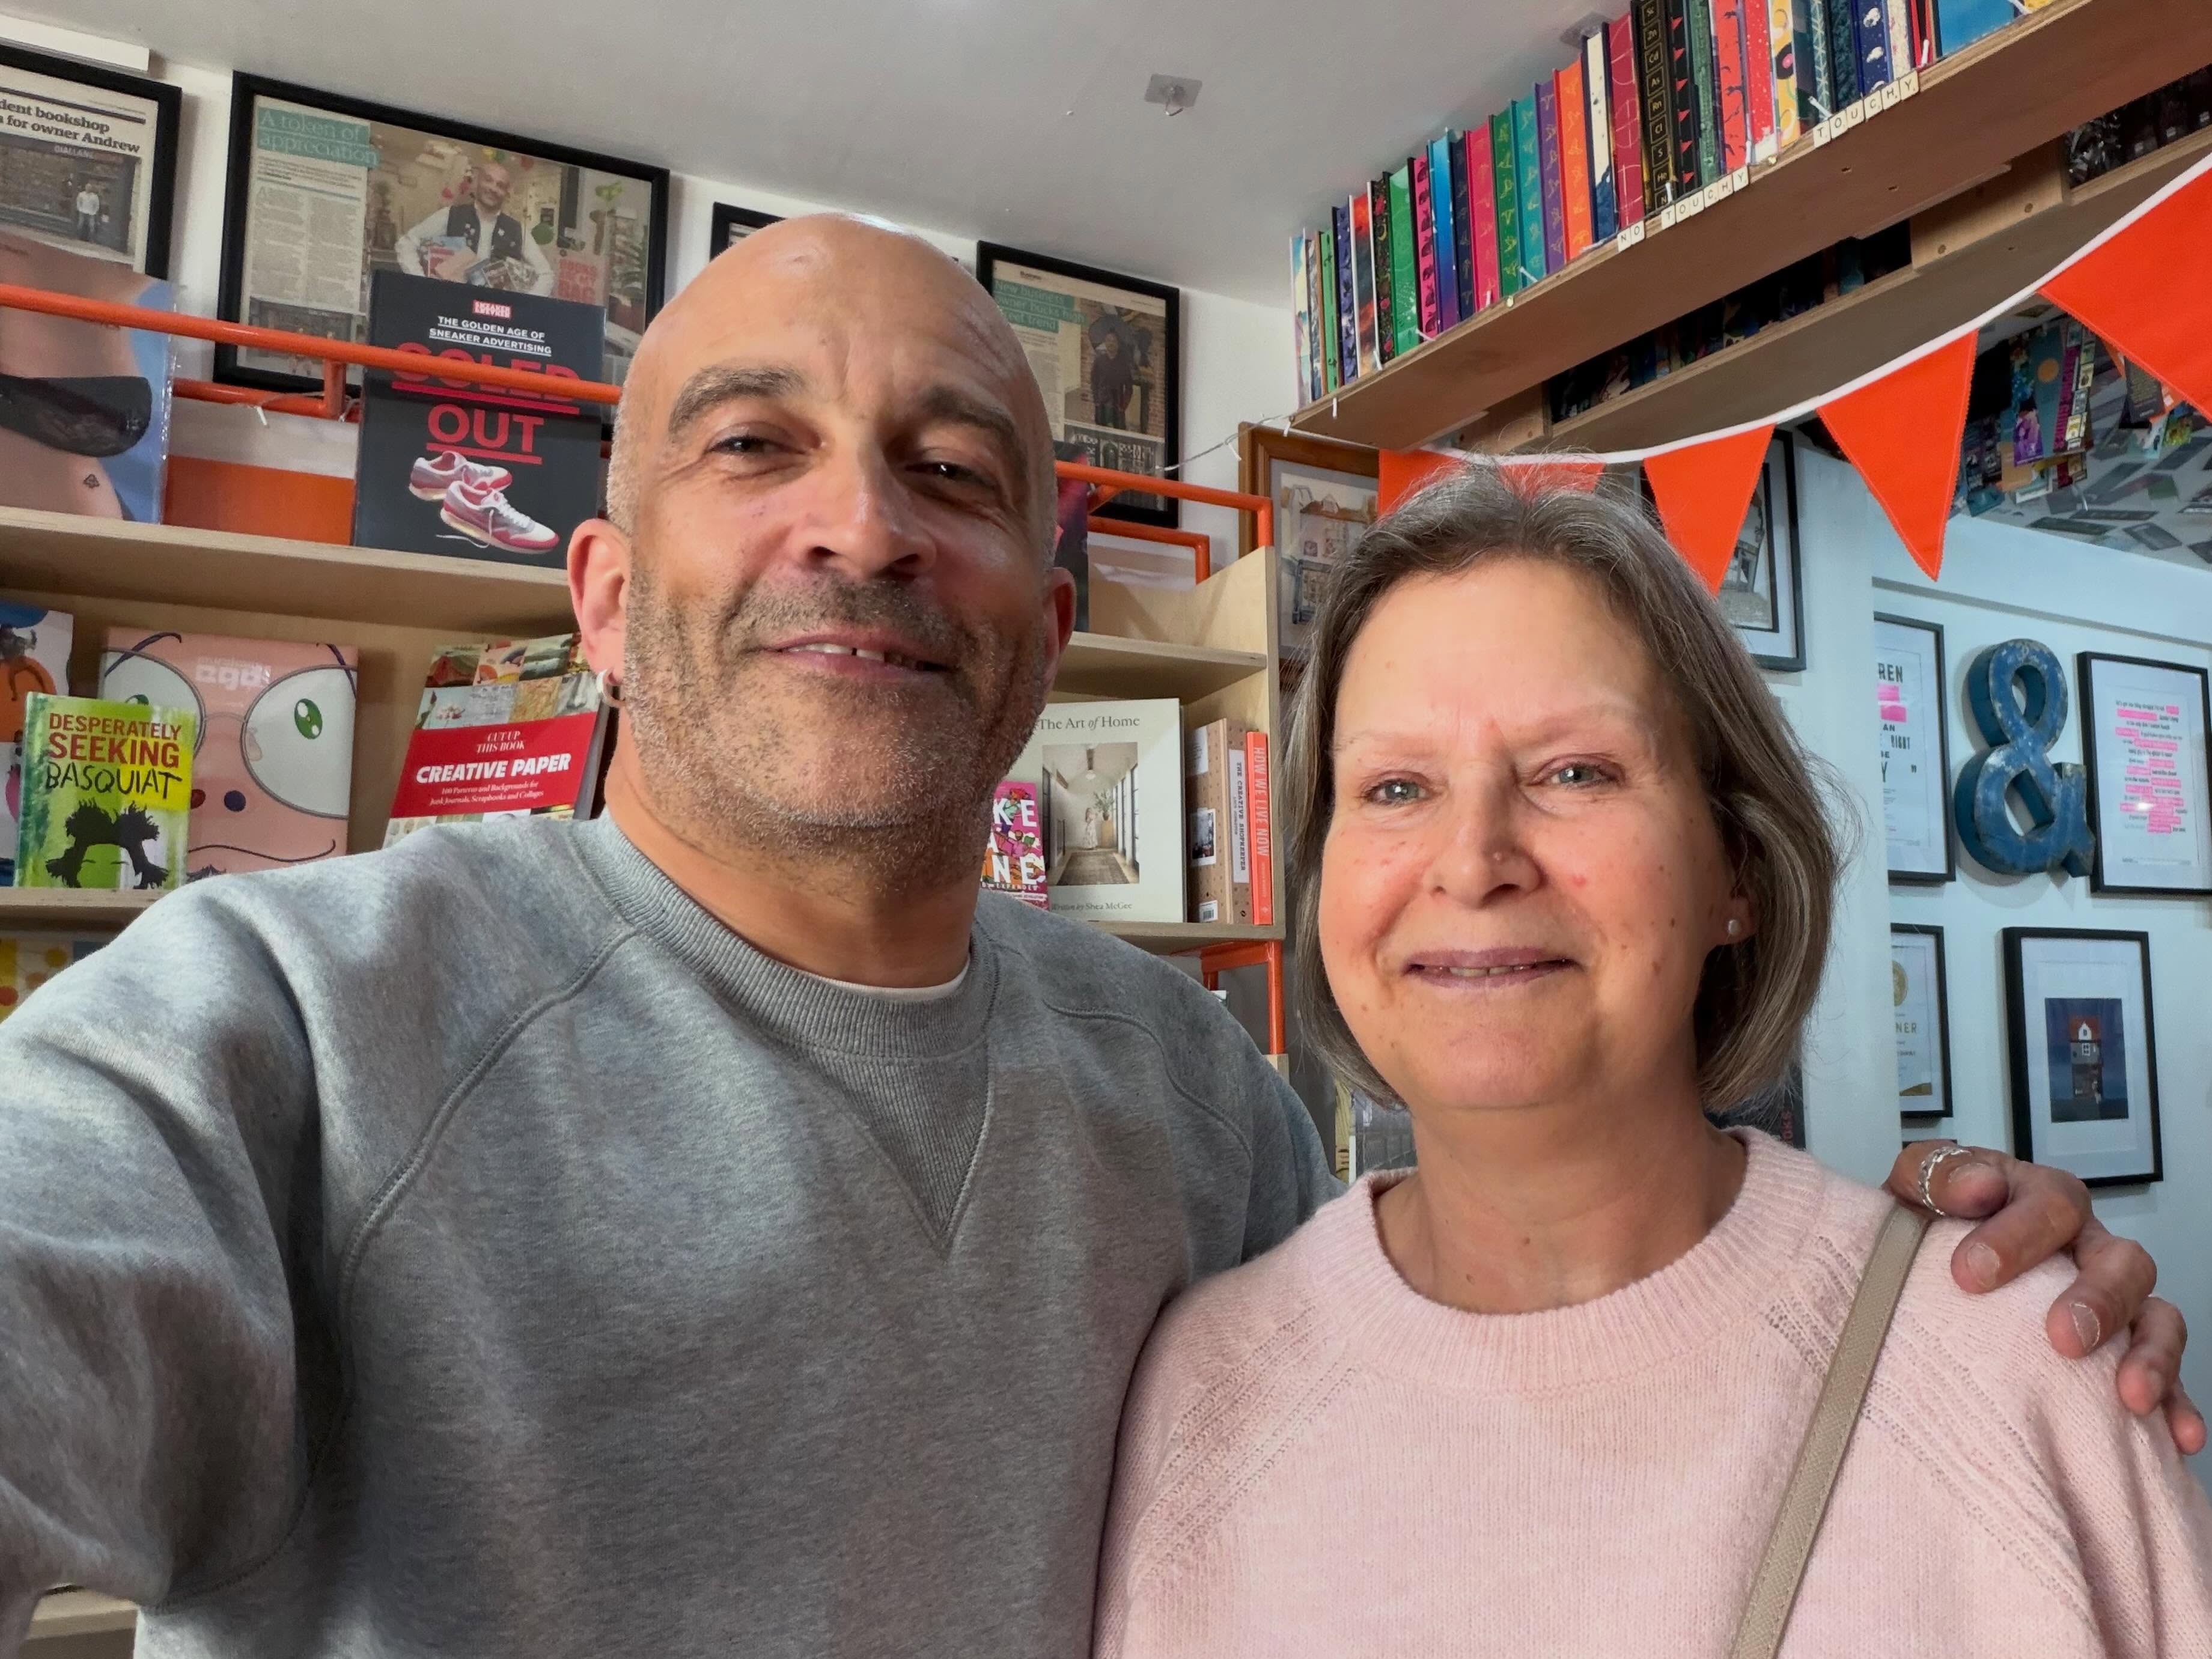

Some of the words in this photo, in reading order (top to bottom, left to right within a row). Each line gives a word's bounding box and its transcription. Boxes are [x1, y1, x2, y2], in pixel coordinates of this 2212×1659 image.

[1648, 51, 1659, 63] Cd
[0, 99, 32, 116] dent
[35, 106, 110, 135] bookshop
[260, 110, 275, 127] A
[281, 114, 336, 138] token
[341, 126, 361, 141] of
[7, 115, 29, 129] for
[31, 122, 81, 140] owner
[81, 132, 141, 153] Andrew
[259, 133, 379, 165] appreciation
[1621, 226, 1640, 241] NO
[1666, 172, 1744, 220] TOUCHY
[1817, 79, 1912, 138] TOUCHY
[437, 315, 459, 327] THE
[461, 320, 505, 333] GOLDEN
[507, 328, 528, 338] AGE
[530, 331, 546, 341] OF
[1028, 312, 1056, 330] trend
[429, 328, 481, 343] SNEAKER
[483, 337, 552, 355] ADVERTISING
[427, 403, 545, 452] OUT
[49, 712, 183, 741] DESPERATELY
[487, 731, 507, 742] CUT
[508, 730, 521, 740] UP
[1038, 719, 1062, 730] The
[1065, 717, 1085, 729] Art
[1088, 716, 1101, 731] of
[1102, 716, 1140, 728] Home
[47, 731, 180, 769] SEEKING
[477, 743, 498, 753] THIS
[499, 740, 525, 751] BOOK
[1254, 747, 1267, 774] HOW
[45, 761, 183, 800] BASQUIAT
[415, 759, 508, 784] CREATIVE
[510, 752, 572, 777] PAPER
[471, 794, 506, 804] Scrapbooks
[507, 792, 519, 800] and
[1255, 778, 1267, 796] WE
[1255, 799, 1269, 823] LIVE
[1257, 828, 1270, 857] NOW
